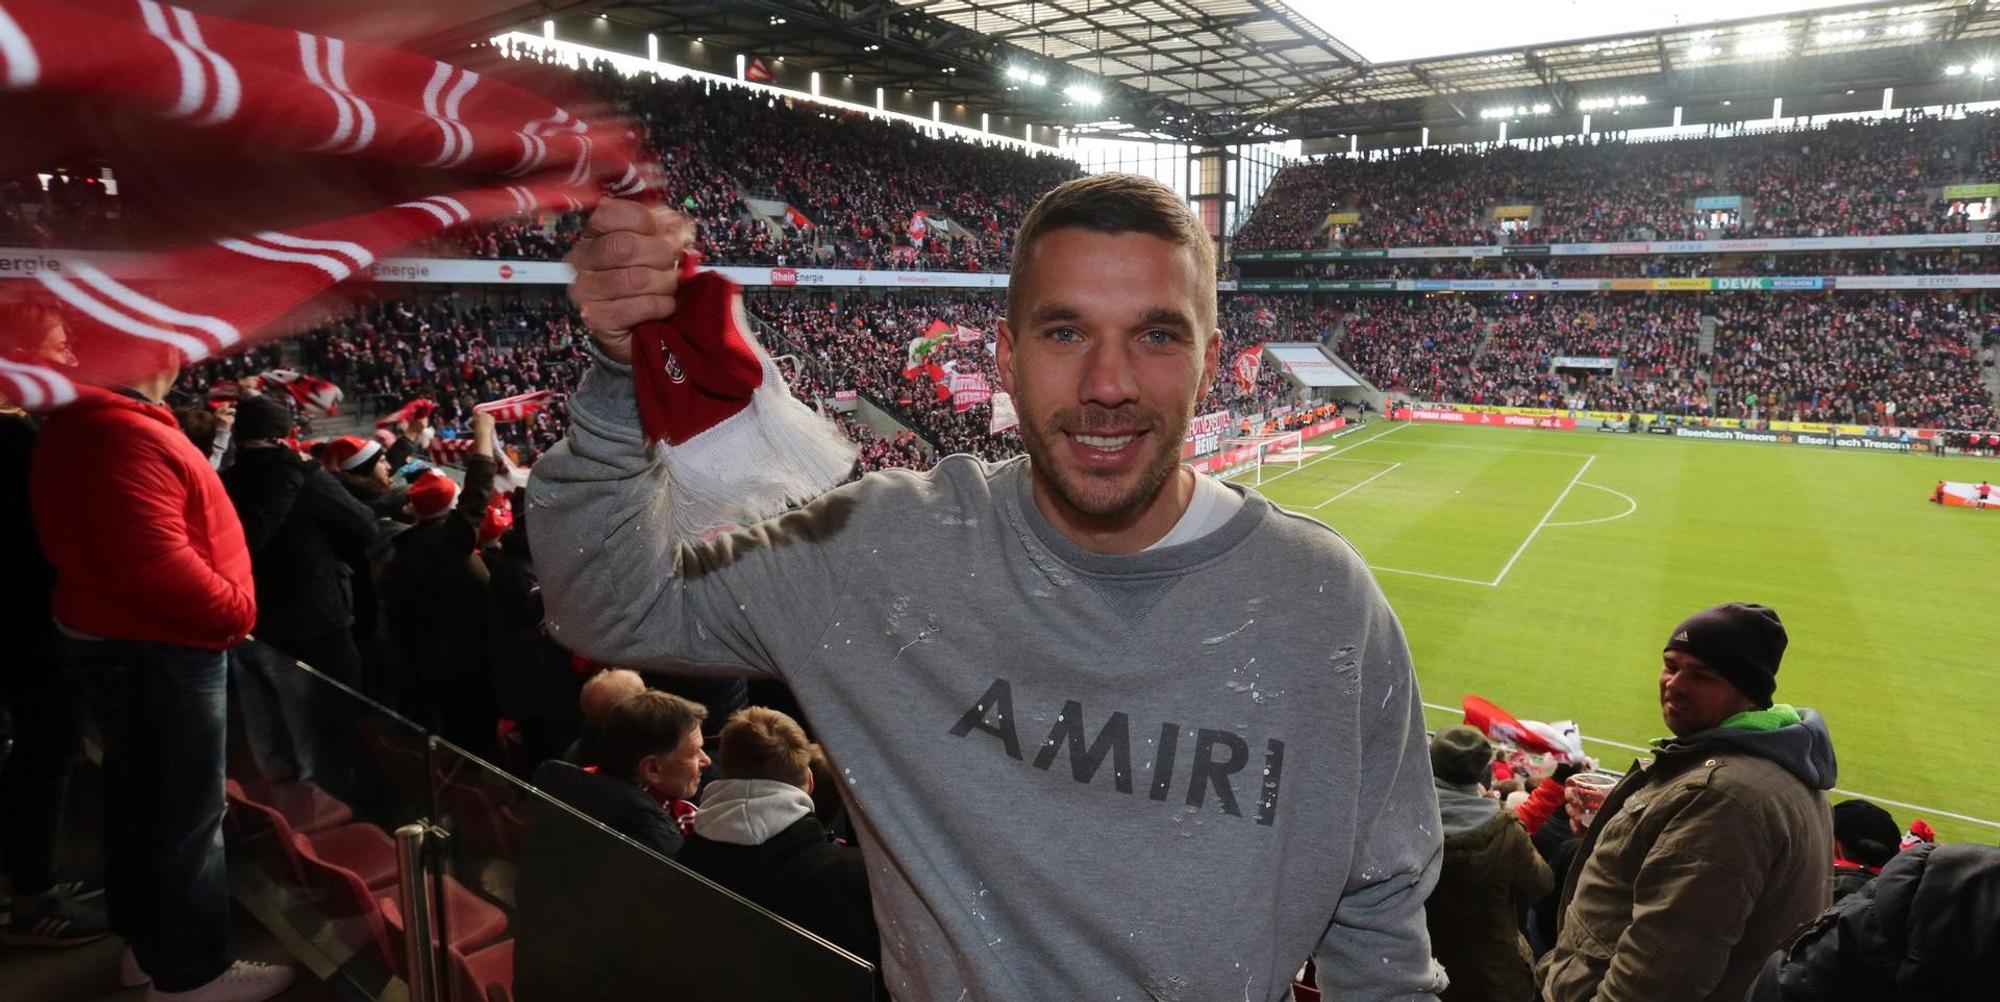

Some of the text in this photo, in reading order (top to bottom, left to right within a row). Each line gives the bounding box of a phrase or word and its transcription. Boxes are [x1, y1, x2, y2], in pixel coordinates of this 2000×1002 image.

[772, 271, 824, 284] RheinEnergie
[1719, 277, 1763, 290] DEVK
[1195, 435, 1219, 456] REWE
[1798, 435, 1862, 448] Eisenach
[949, 678, 1285, 827] AMIRI
